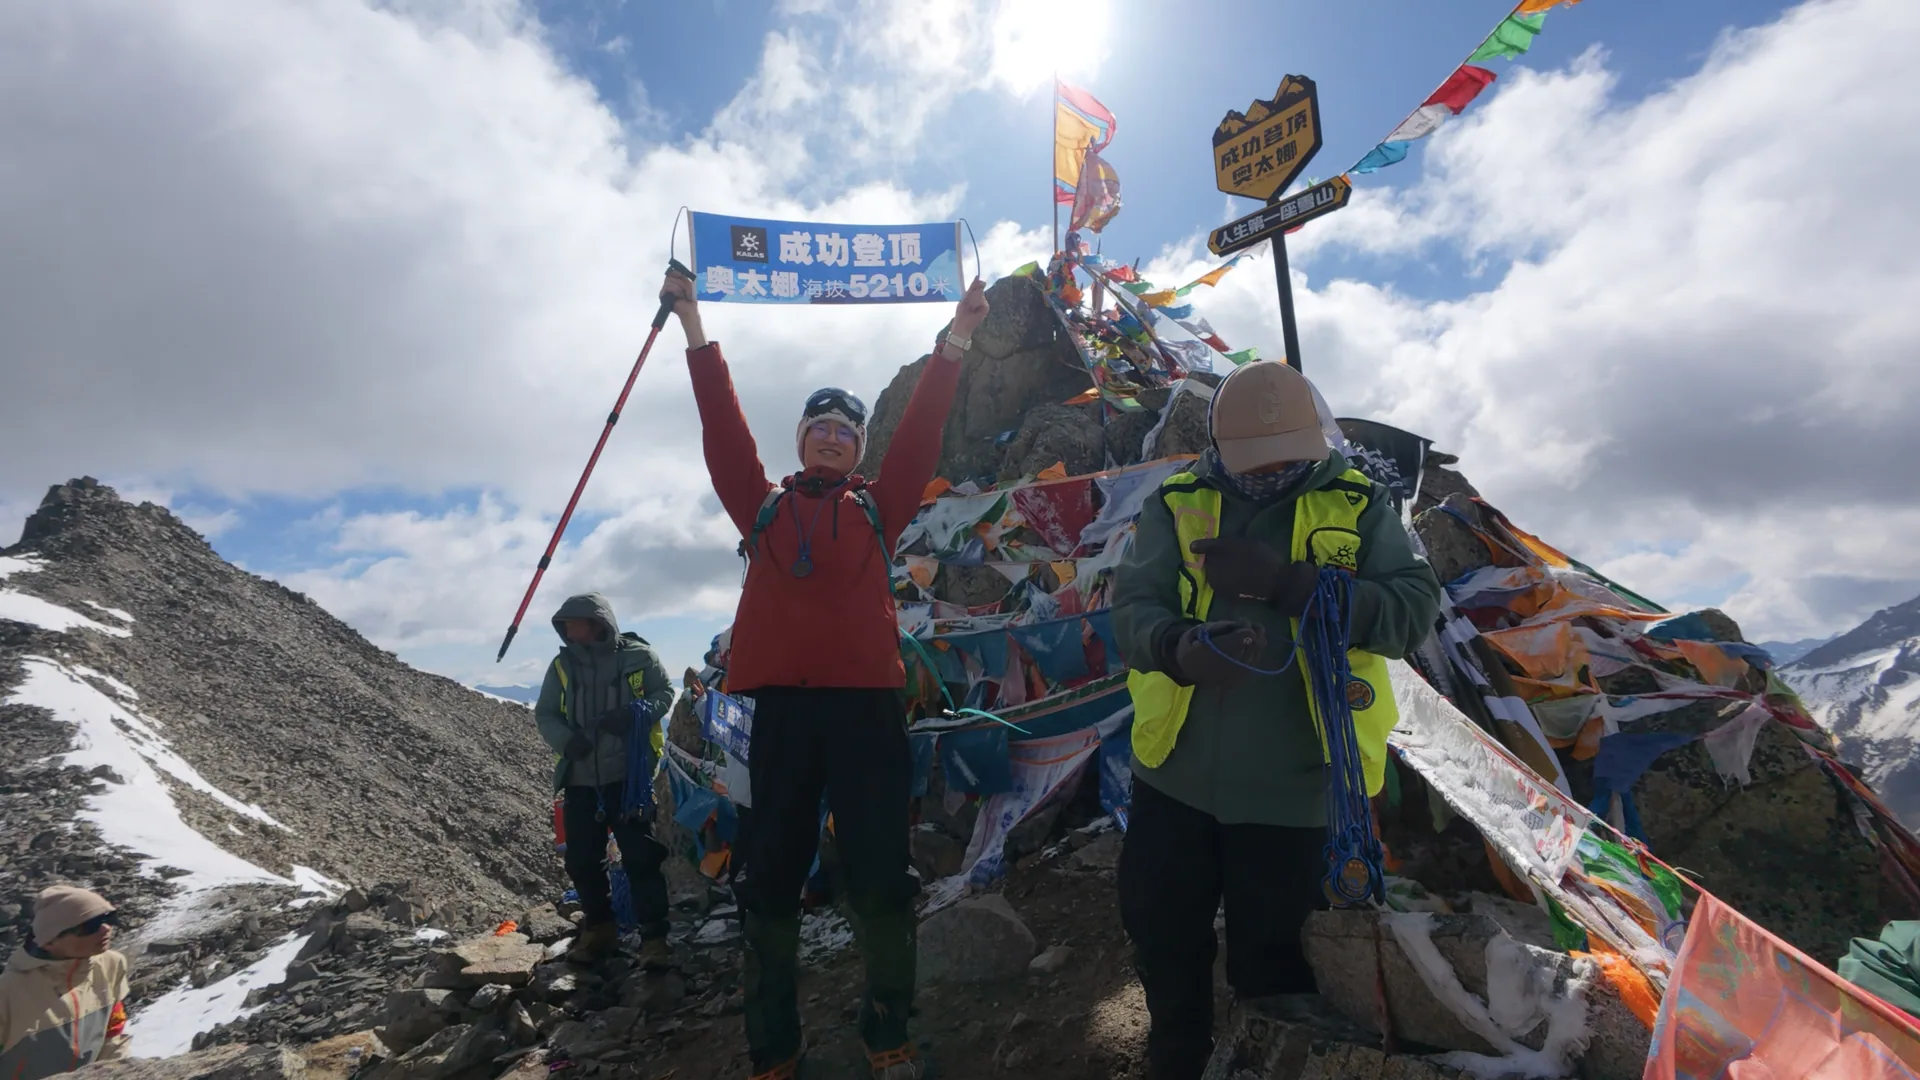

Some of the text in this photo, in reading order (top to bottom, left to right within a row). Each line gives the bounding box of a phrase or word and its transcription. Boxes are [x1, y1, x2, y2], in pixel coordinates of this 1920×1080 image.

[1220, 109, 1308, 171] 成功登顶
[1232, 140, 1298, 187] 奥太娜
[1220, 186, 1335, 248] 人生第一座雪山
[736, 250, 765, 259] KAILAS
[779, 230, 923, 268] 成功登顶
